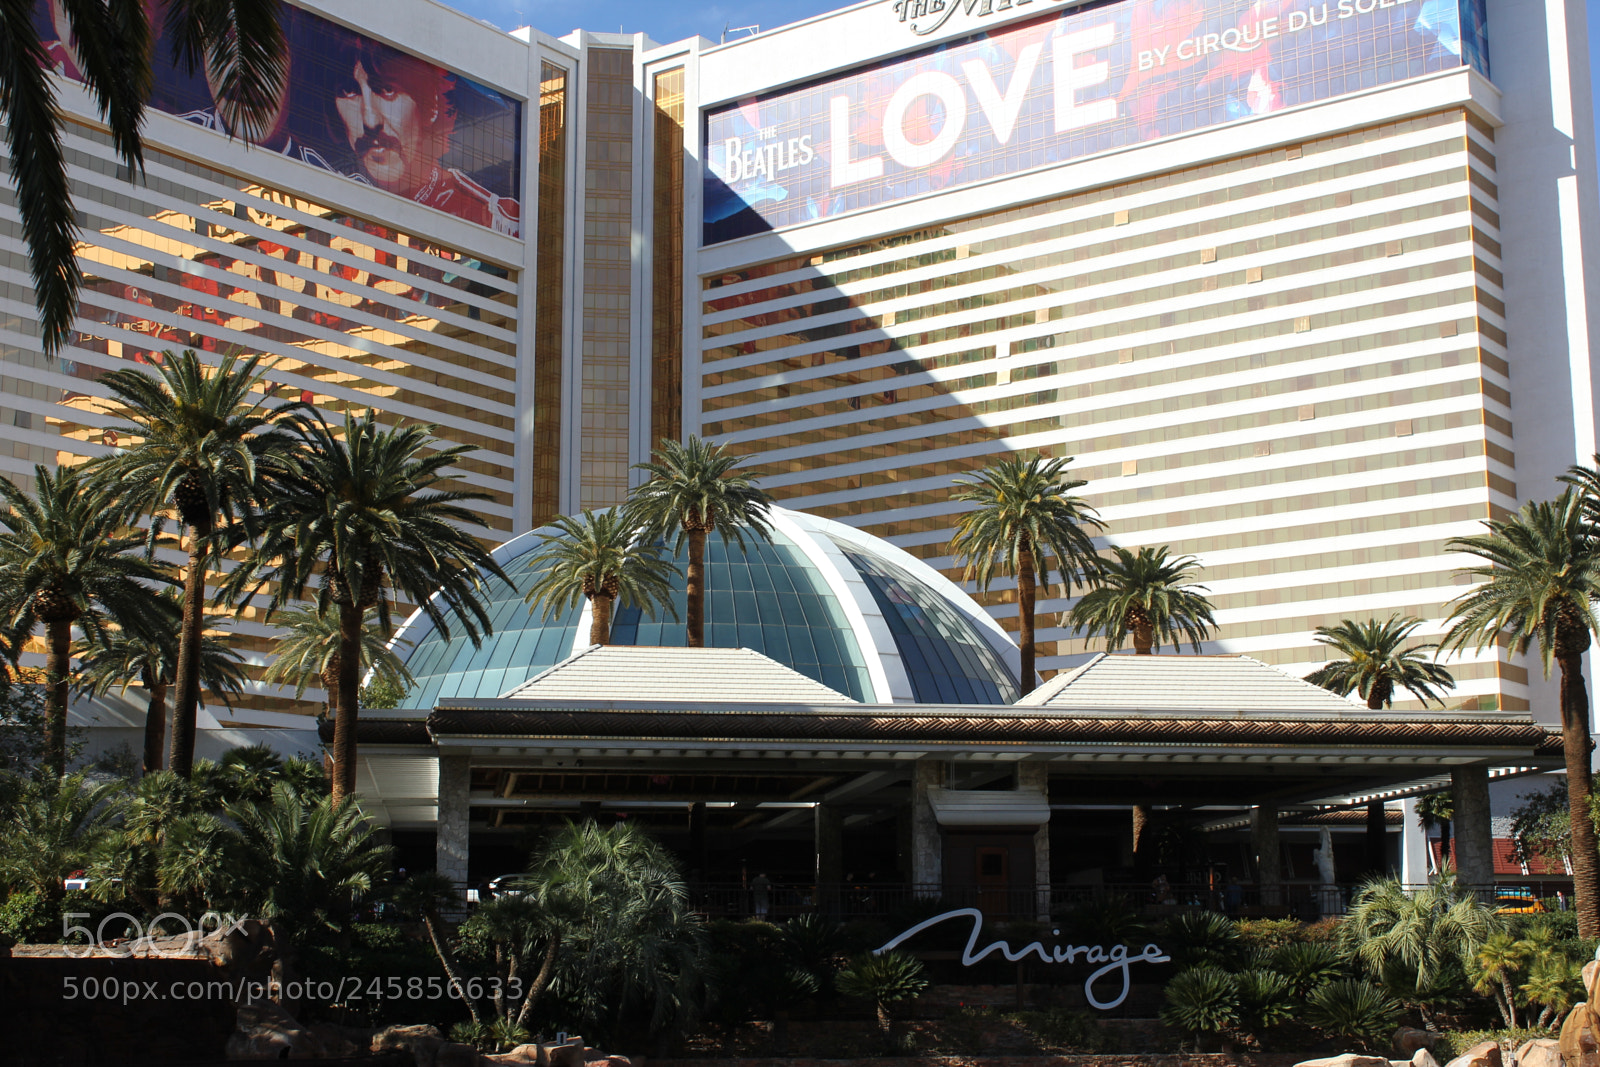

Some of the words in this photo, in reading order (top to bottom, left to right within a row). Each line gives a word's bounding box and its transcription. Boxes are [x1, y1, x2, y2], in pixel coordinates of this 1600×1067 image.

[893, 0, 946, 22] THE
[1138, 45, 1171, 71] BY
[1176, 17, 1279, 60] CIRQUE
[1288, 4, 1327, 32] DU
[830, 21, 1117, 188] LOVE
[758, 126, 778, 141] THE
[725, 135, 814, 184] BEATLES
